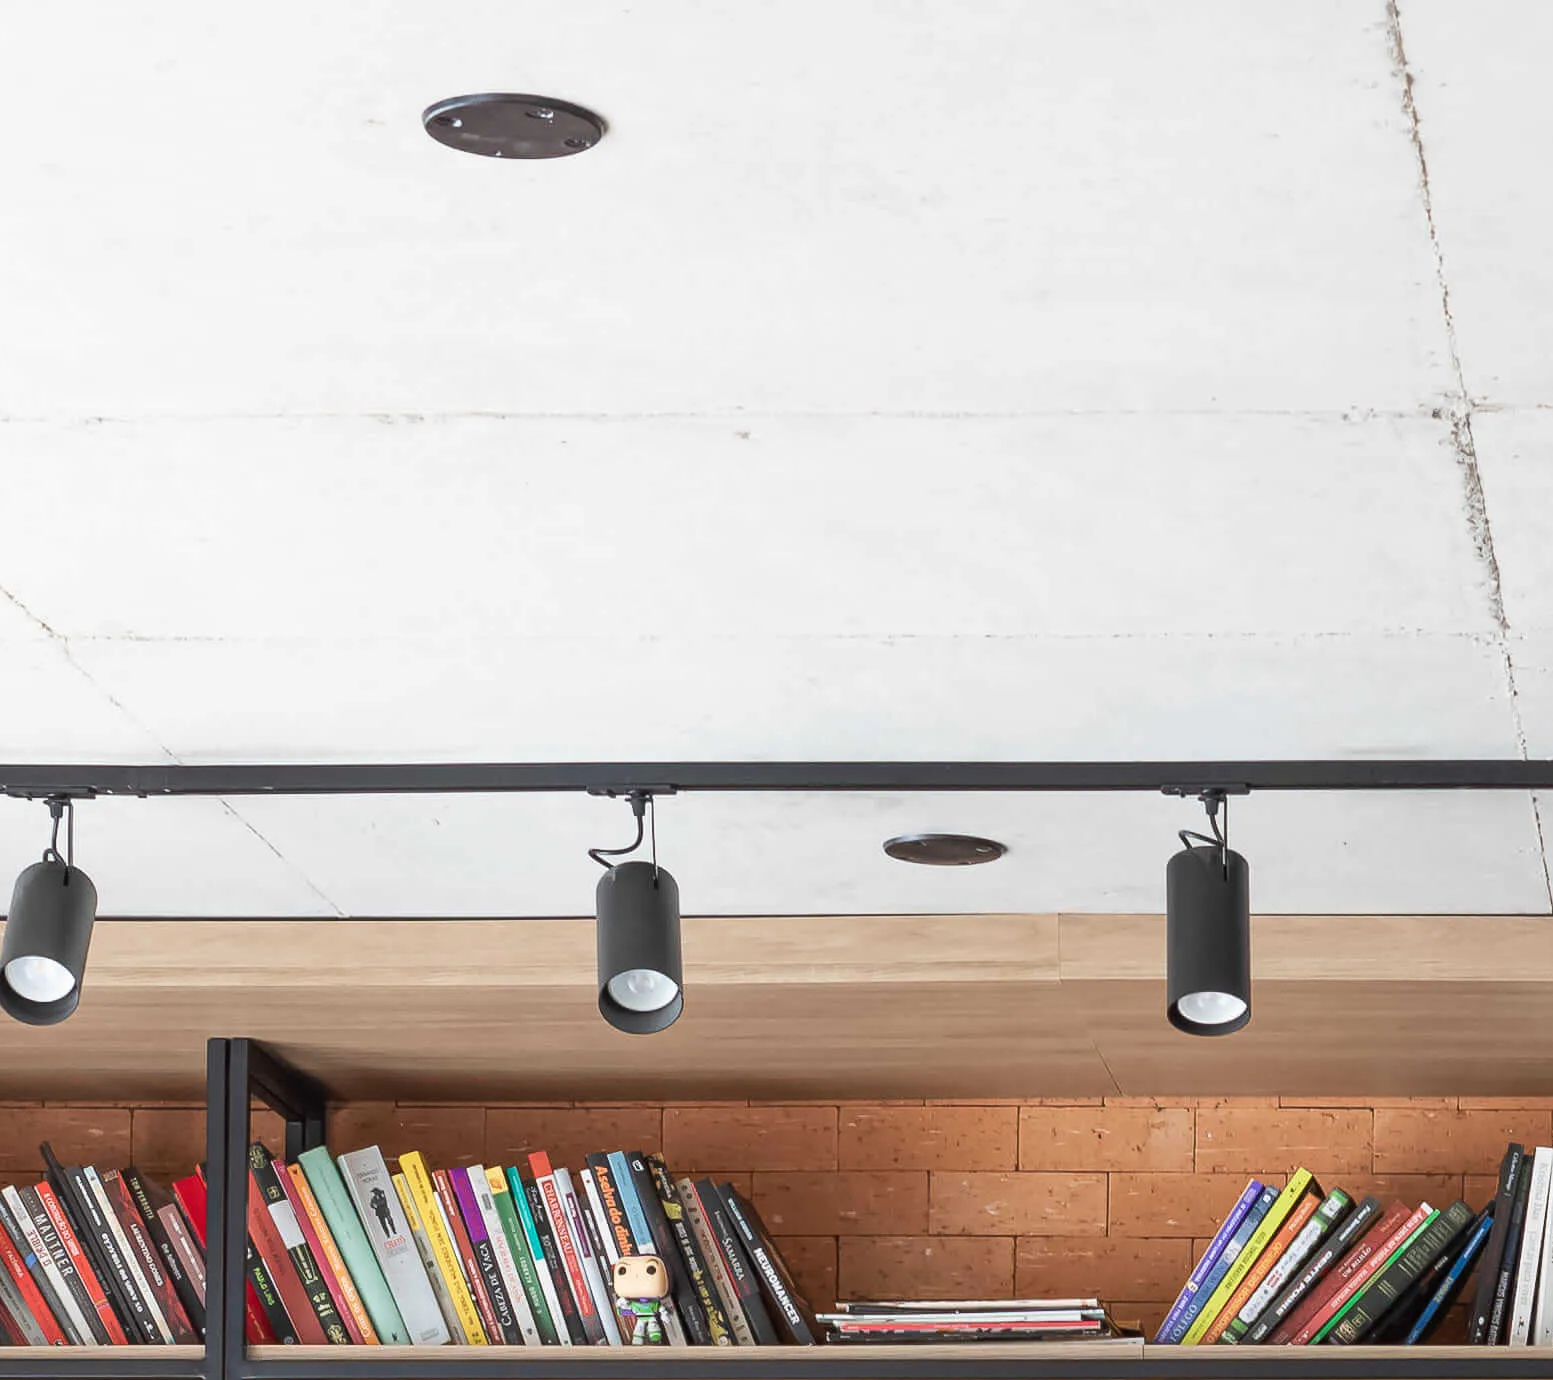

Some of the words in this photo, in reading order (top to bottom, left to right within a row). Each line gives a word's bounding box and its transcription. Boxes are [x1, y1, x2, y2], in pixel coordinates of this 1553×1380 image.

[32, 1210, 76, 1277] MAUTNER
[473, 1242, 495, 1272] VACA
[249, 1265, 269, 1291] PAULO
[261, 1287, 278, 1306] LINS
[484, 1271, 500, 1287] DE
[751, 1245, 802, 1327] NEUROMANCER
[489, 1286, 515, 1328] CABEZA
